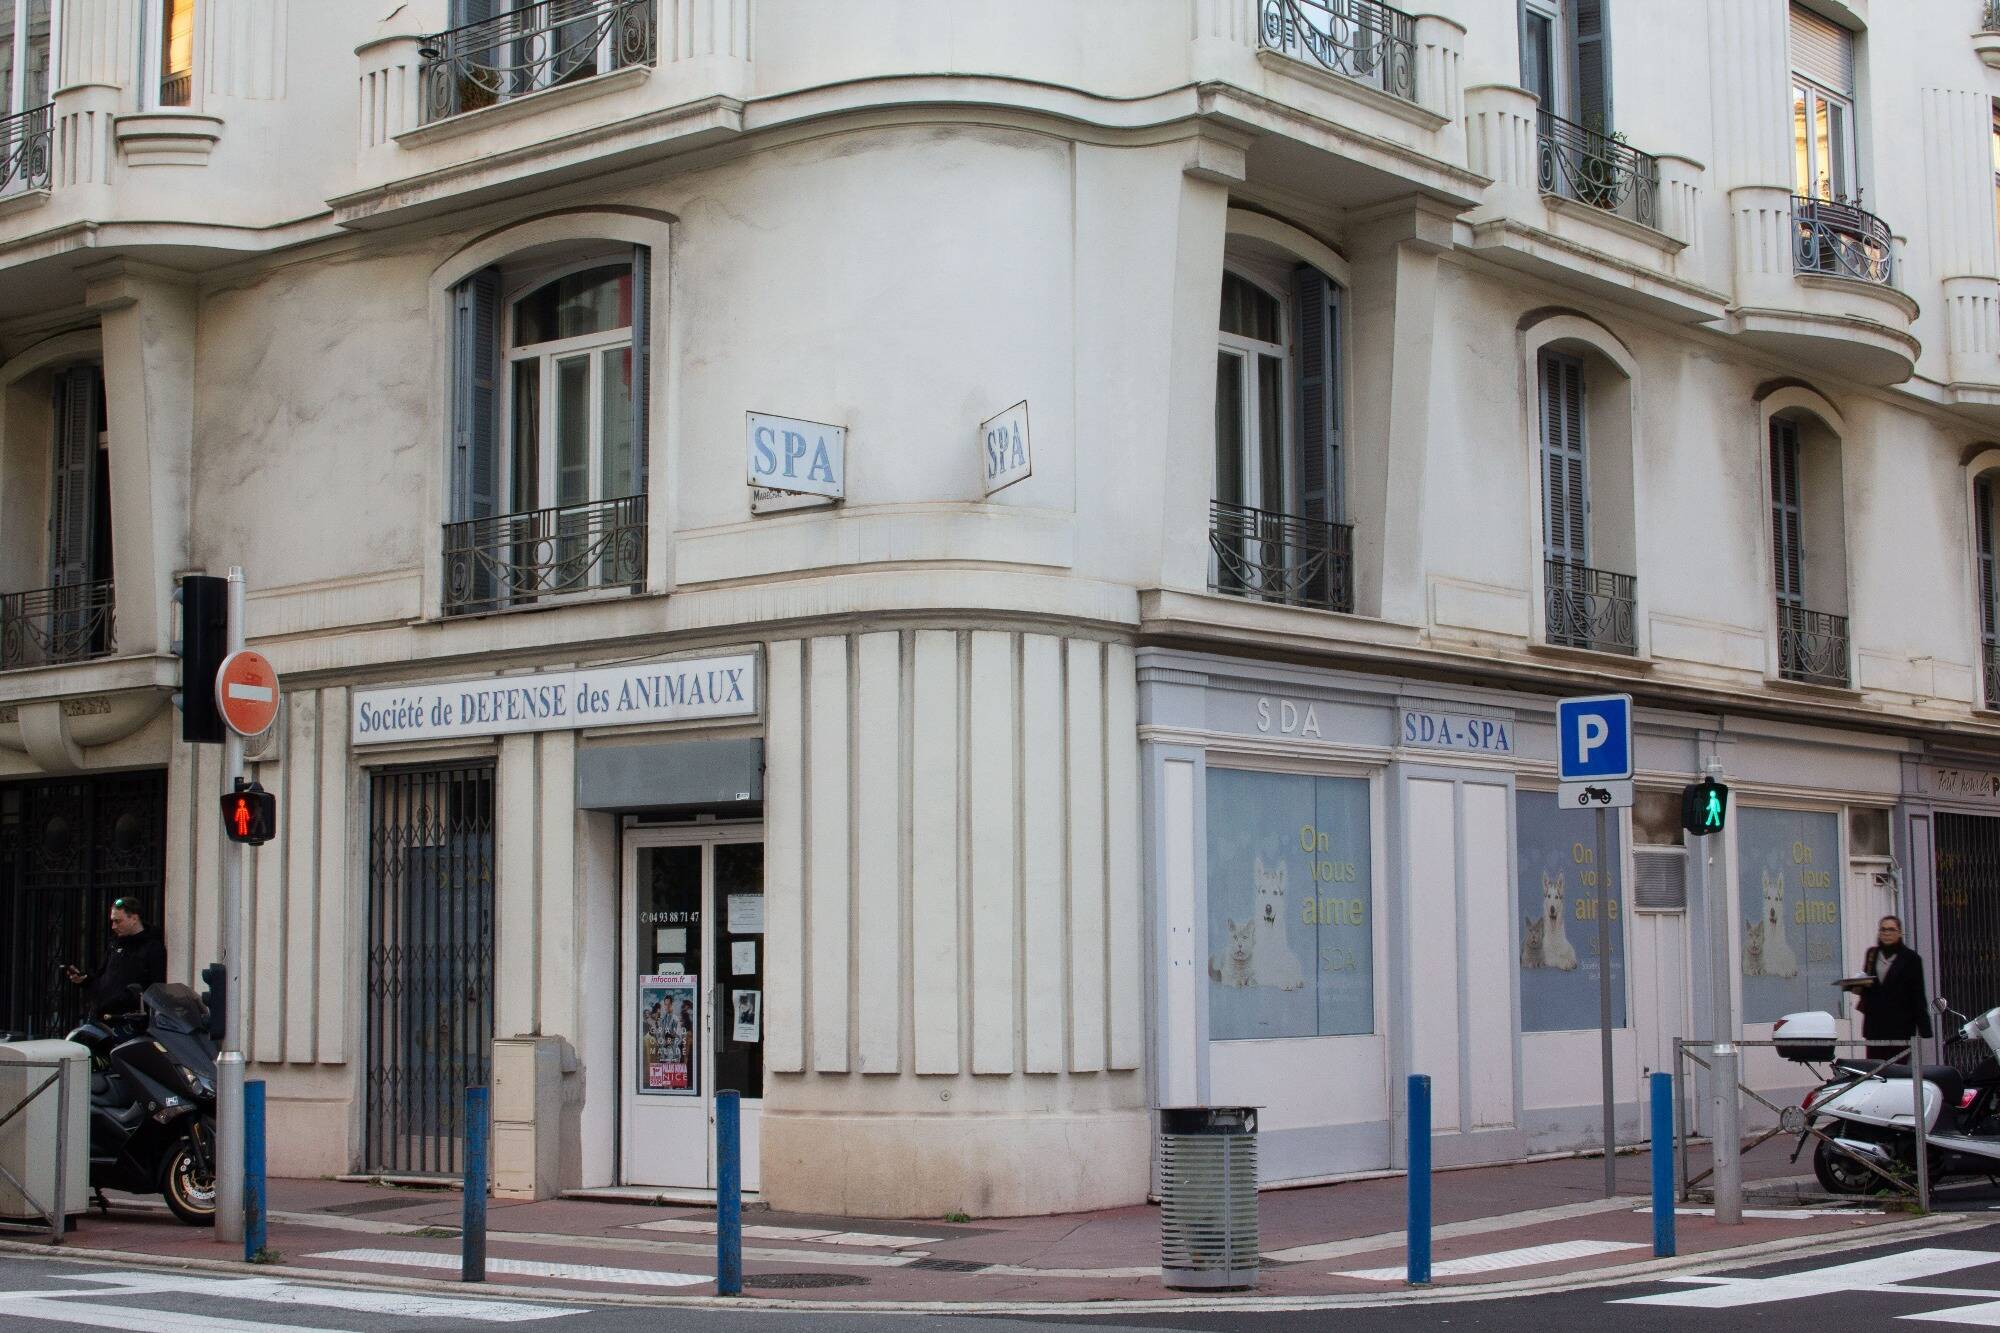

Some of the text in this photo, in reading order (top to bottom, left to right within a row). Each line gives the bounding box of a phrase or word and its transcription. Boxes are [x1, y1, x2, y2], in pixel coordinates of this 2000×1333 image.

[754, 425, 837, 483] SPA
[987, 420, 1027, 479] SPA
[359, 668, 745, 733] Société de DEFENSE des ANIMAUX
[1256, 697, 1321, 738] SDA
[1405, 711, 1510, 751] SDA-SPA
[1577, 714, 1609, 764] P
[1300, 824, 1329, 853] On
[1572, 842, 1593, 864] On
[1792, 841, 1813, 865] On
[1309, 861, 1356, 883] vous
[1580, 870, 1612, 888] vos
[1801, 869, 1830, 889] vous
[649, 911, 699, 923] 04 93 88 71 47
[1302, 889, 1365, 926] aime
[651, 975, 685, 984] infocom.fr
[650, 1037, 687, 1046] CORPS
[663, 1072, 688, 1081] NICE
